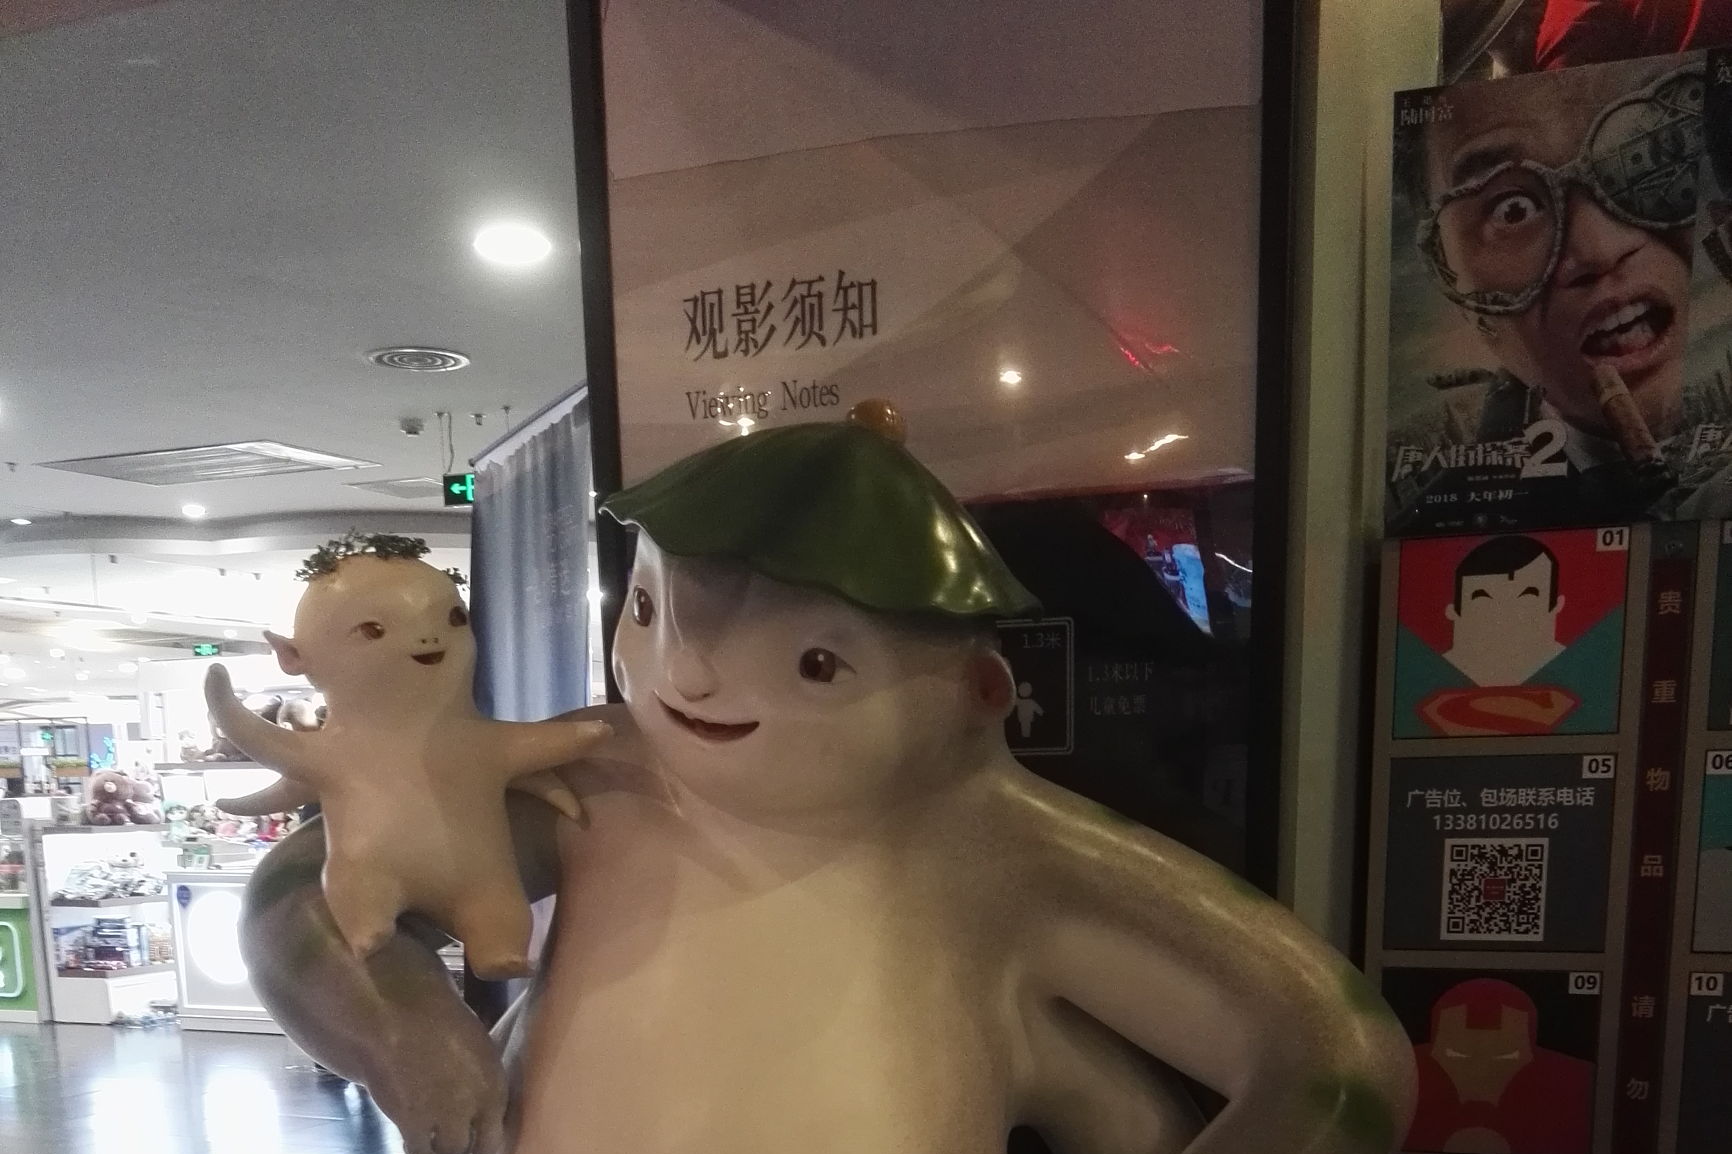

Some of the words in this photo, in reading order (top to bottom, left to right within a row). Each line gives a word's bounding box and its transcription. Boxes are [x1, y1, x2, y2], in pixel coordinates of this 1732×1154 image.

[683, 269, 878, 362] 观影须知
[685, 388, 769, 420] Viewing
[780, 379, 840, 411] Notes
[1425, 493, 1459, 504] 2018
[1467, 488, 1529, 503] 大年初一
[1602, 529, 1624, 546] 01
[1022, 631, 1062, 650] 1.3米
[1588, 757, 1612, 775] 05
[1432, 812, 1560, 831] 13381026516
[1573, 975, 1597, 991] 09
[1695, 975, 1718, 991] 10
[1705, 1003, 1732, 1024] 广
